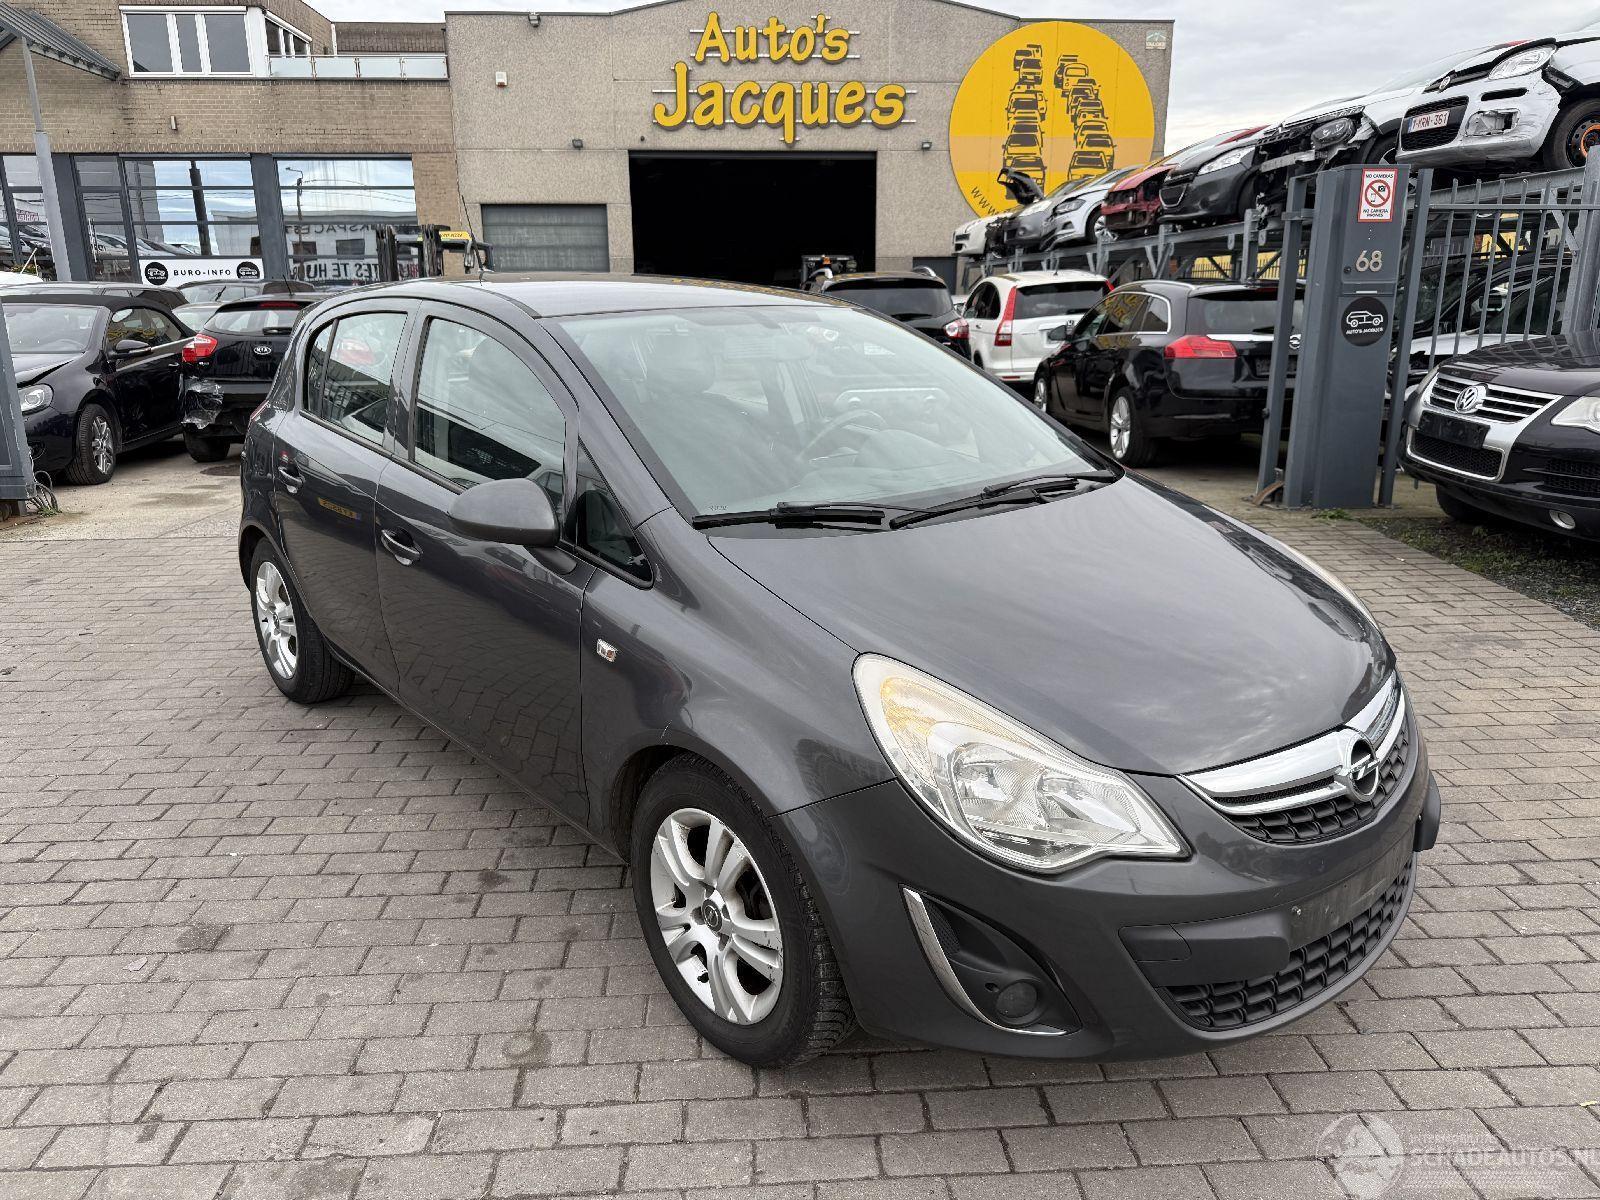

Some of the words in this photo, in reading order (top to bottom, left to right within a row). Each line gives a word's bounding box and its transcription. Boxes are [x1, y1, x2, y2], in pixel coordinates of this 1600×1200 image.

[694, 11, 850, 63] Auto's
[653, 61, 907, 144] Jacques
[1355, 250, 1383, 272] 68
